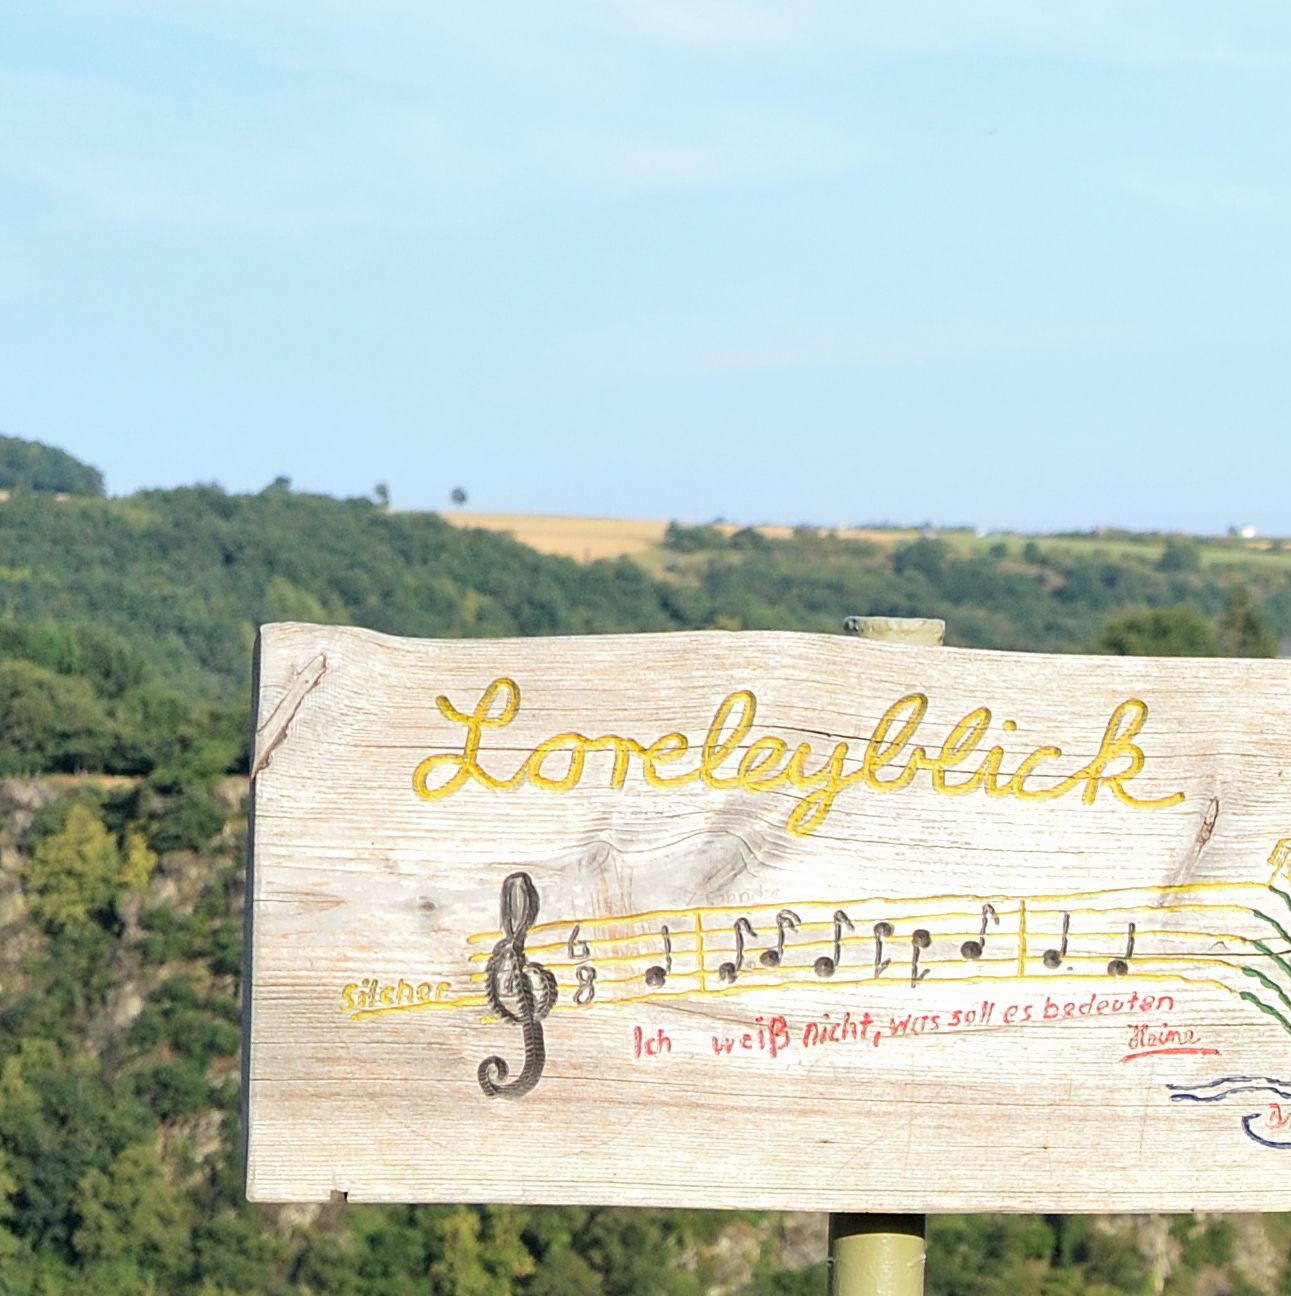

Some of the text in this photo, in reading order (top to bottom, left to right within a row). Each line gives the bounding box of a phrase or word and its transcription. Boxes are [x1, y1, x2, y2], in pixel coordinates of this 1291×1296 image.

[411, 676, 1186, 836] Loreleyblick
[572, 965, 597, 1005] 8
[634, 991, 1175, 1059] Ich weiß nicht, was soll es bedeuten
[1127, 1022, 1202, 1050] Heine
